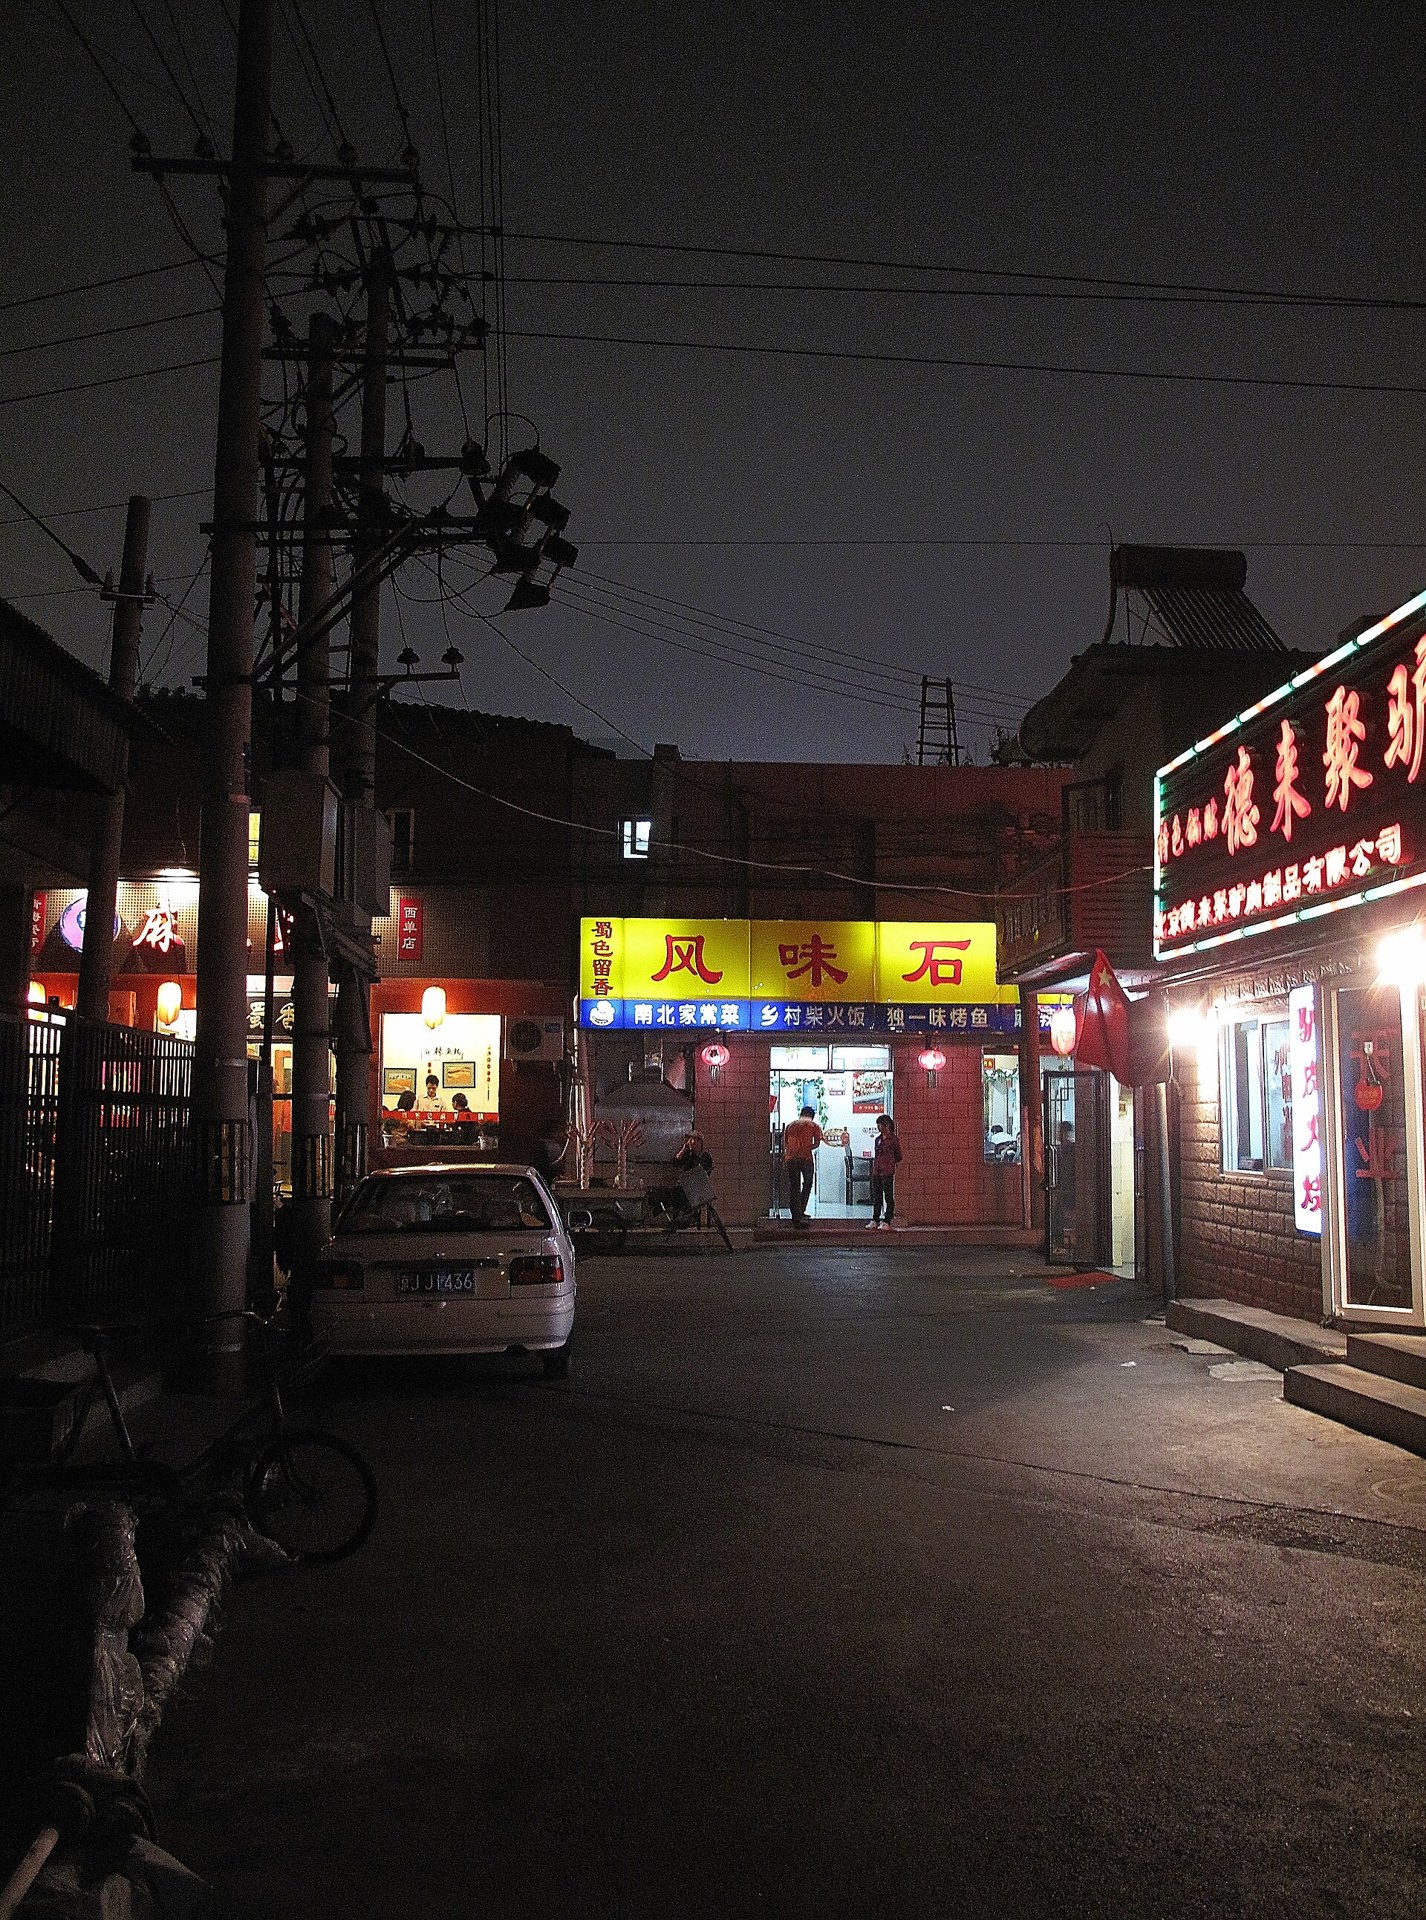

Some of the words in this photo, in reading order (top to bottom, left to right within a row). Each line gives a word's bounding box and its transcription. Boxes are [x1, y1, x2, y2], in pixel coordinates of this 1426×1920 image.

[402, 907, 418, 949] 西单店
[591, 920, 613, 995] 蜀色留香
[651, 934, 972, 987] 风味石
[633, 1004, 740, 1025] 南北家常菜
[761, 1006, 866, 1027] 乡村柴火饭
[887, 1007, 988, 1028] 独一味烤鱼
